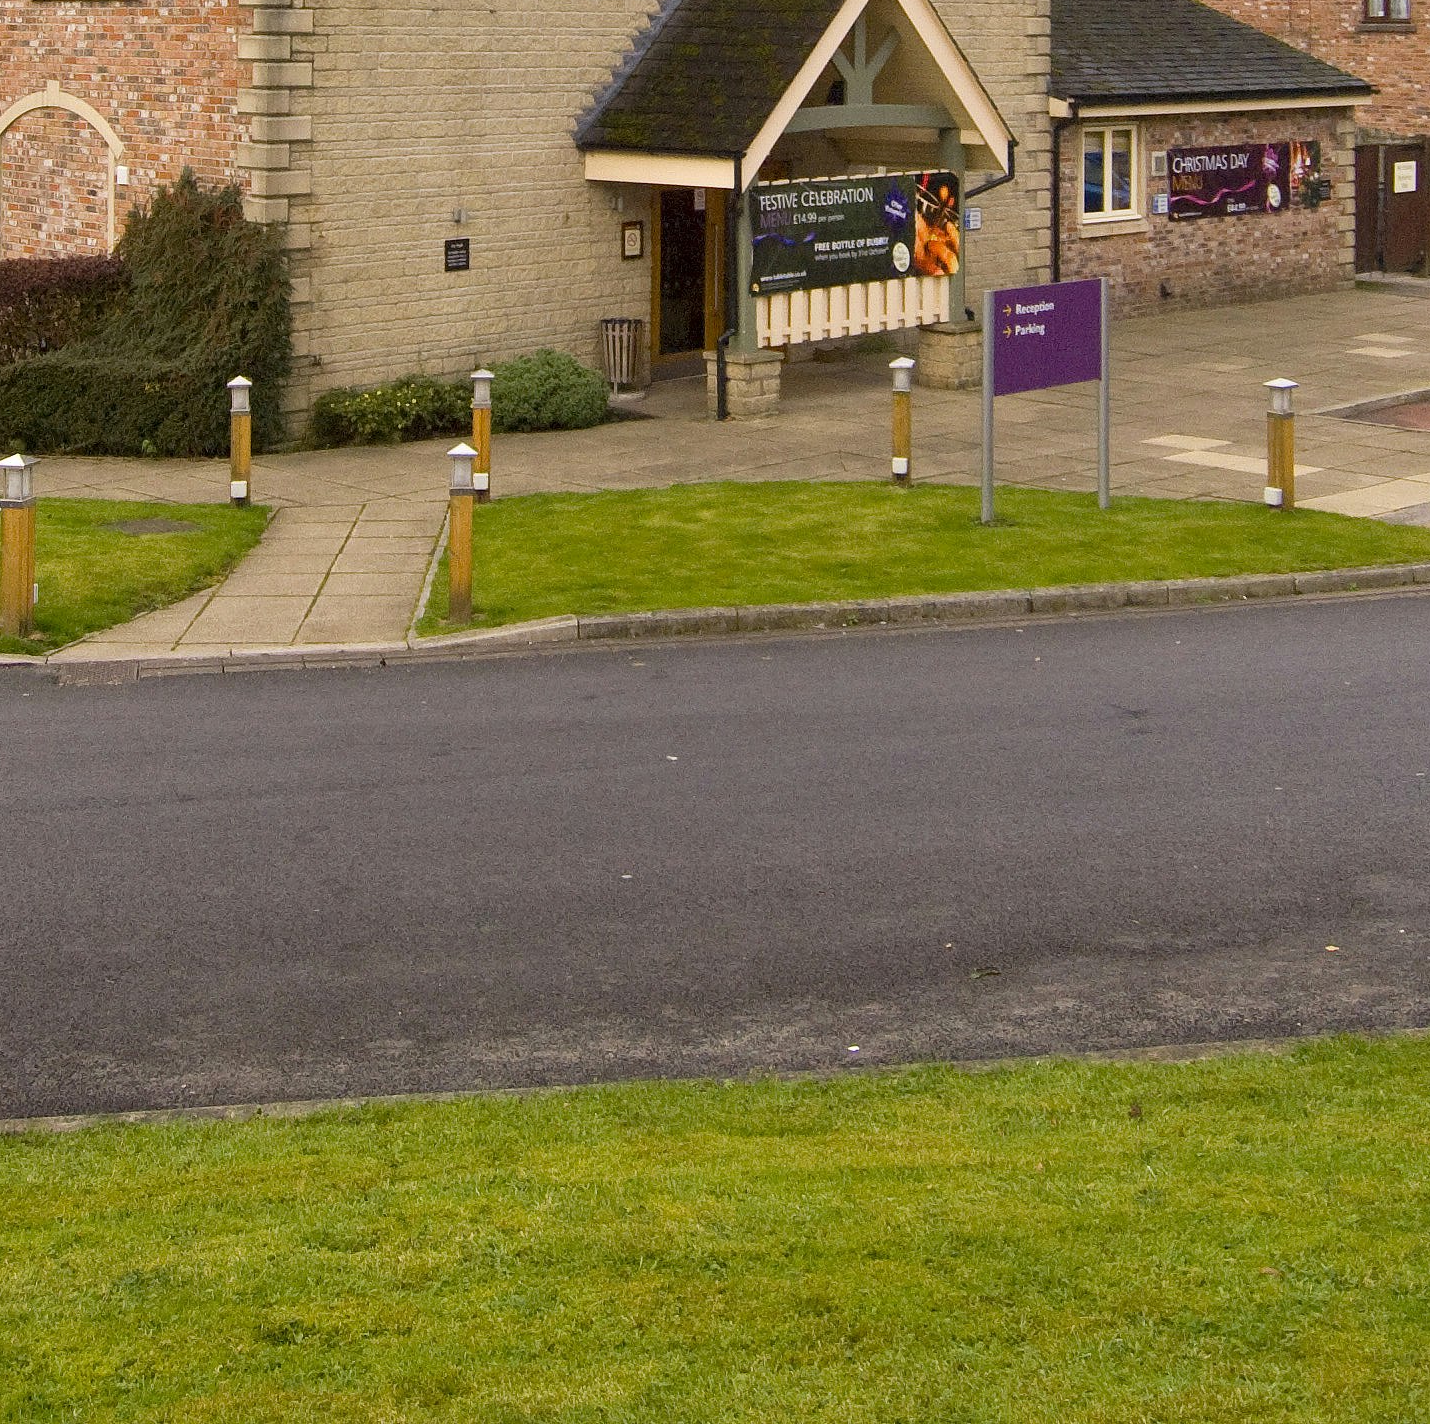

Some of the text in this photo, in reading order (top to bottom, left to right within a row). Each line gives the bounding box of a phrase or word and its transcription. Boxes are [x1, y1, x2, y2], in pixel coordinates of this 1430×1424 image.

[1172, 154, 1228, 173] CHRISTMAS
[1230, 153, 1250, 169] DAY
[1172, 175, 1203, 190] MENU
[759, 187, 874, 211] FESTIVE CELEBRATION
[760, 211, 791, 228] MENU
[793, 211, 817, 225] £14.99
[814, 242, 830, 252] FREE
[831, 240, 856, 250] BOTTLE
[856, 238, 866, 248] OF
[1015, 301, 1055, 315] Reception
[1015, 323, 1046, 336] Parking
